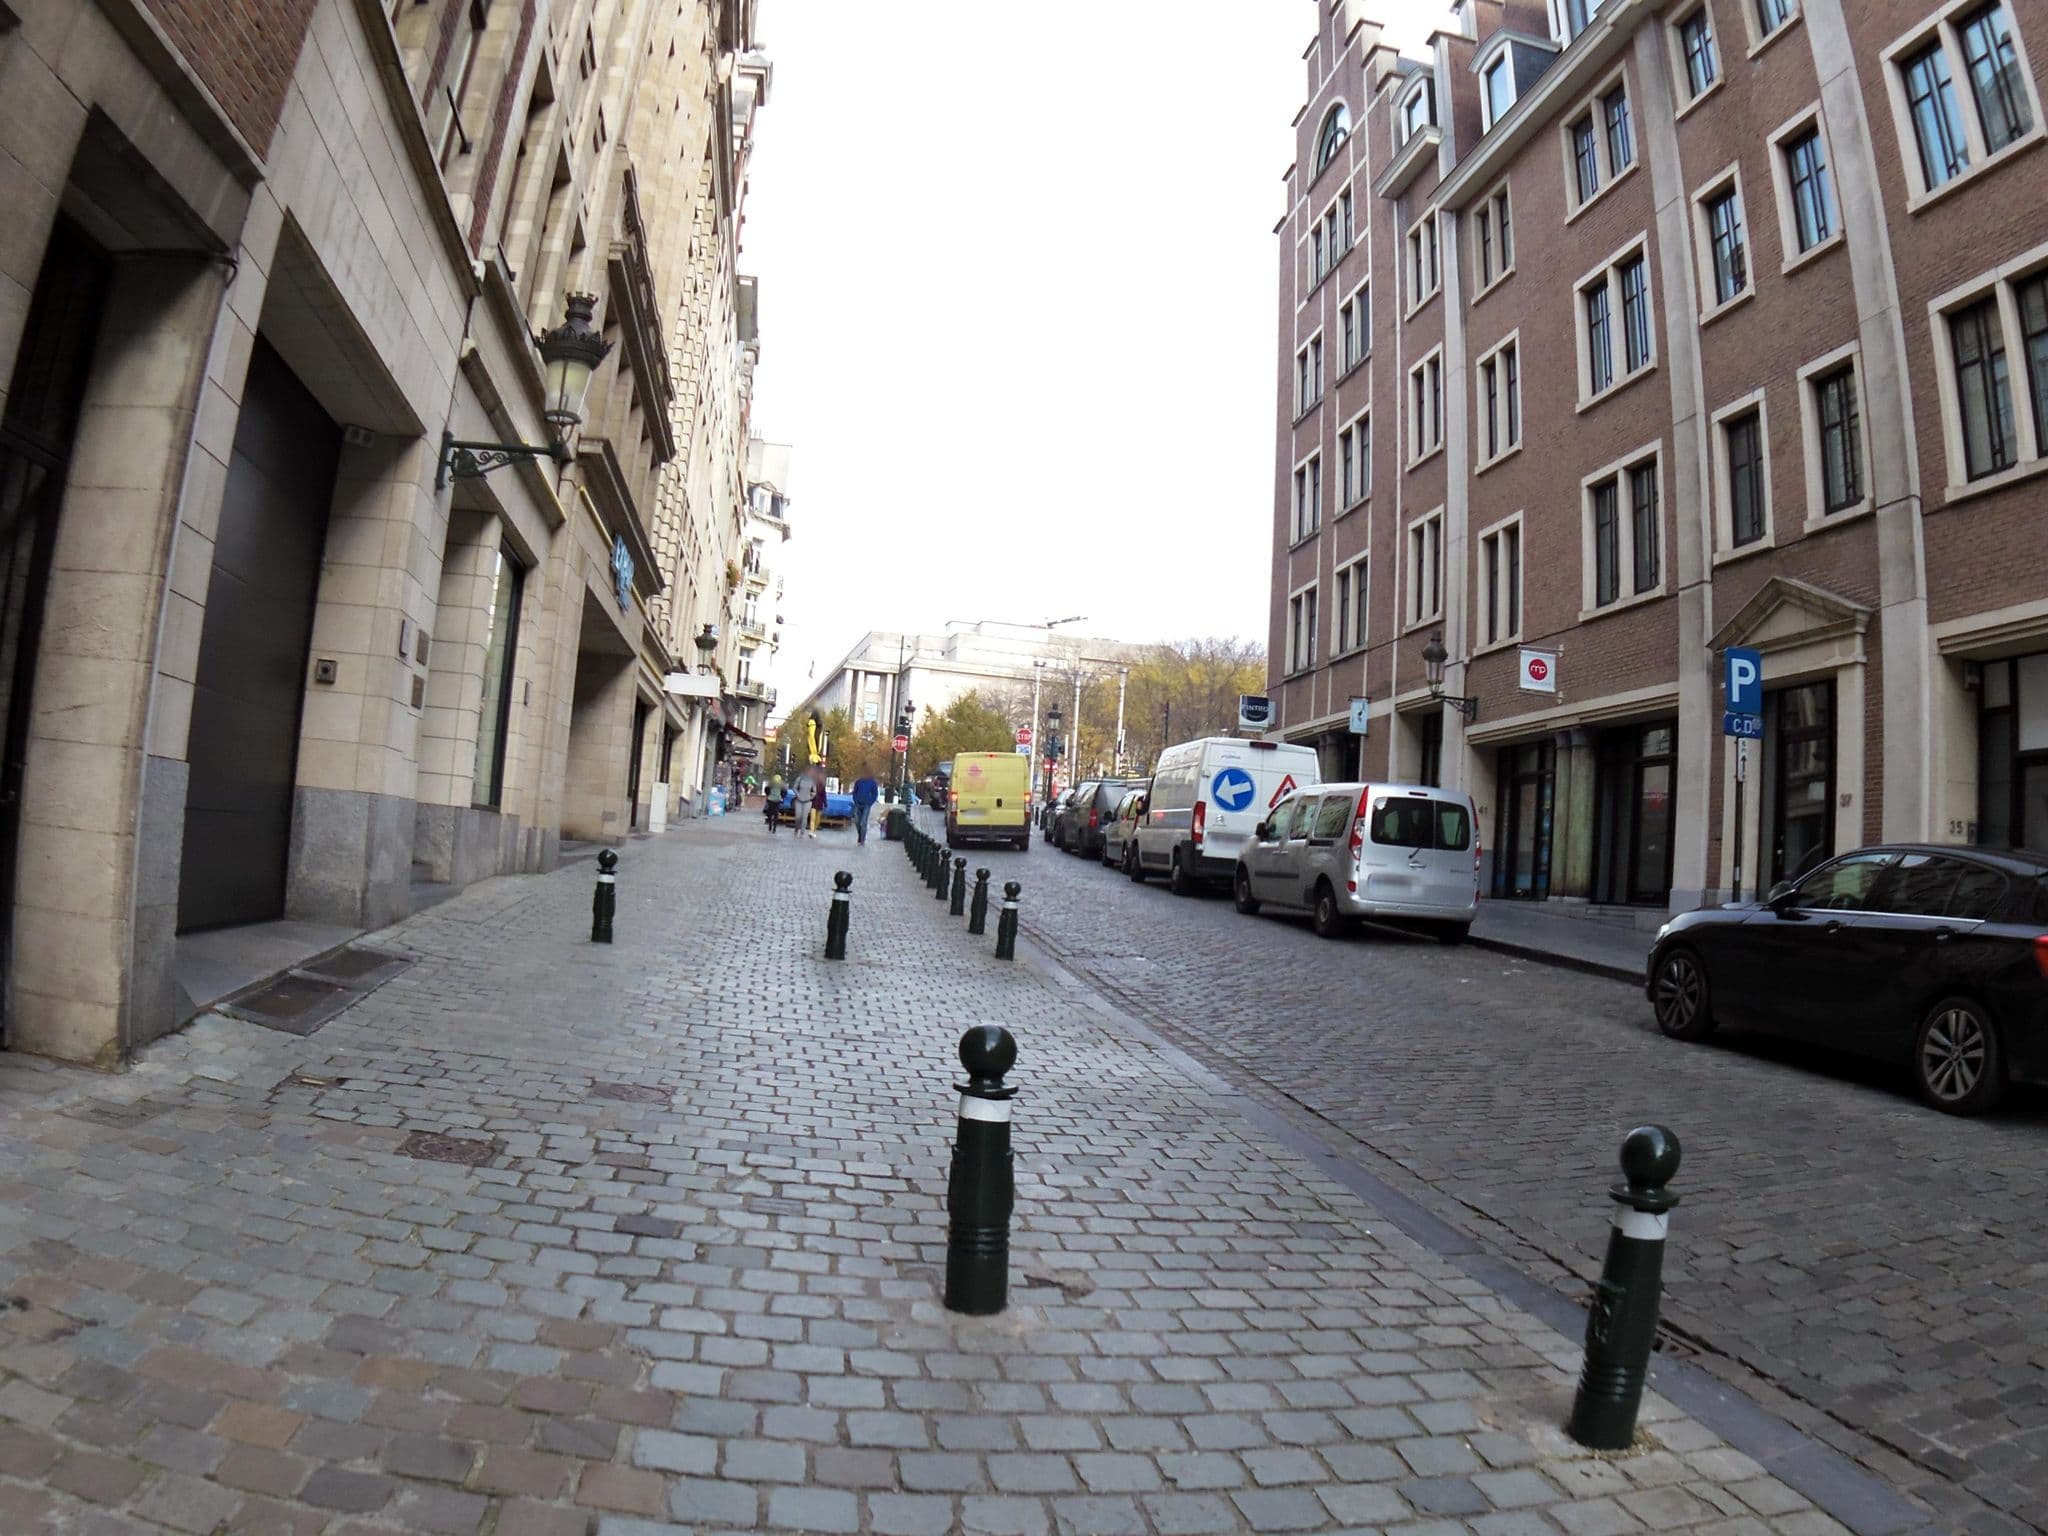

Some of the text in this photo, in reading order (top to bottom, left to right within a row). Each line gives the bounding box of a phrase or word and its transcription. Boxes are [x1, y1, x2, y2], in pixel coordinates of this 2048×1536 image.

[1731, 657, 1756, 703] P
[893, 739, 909, 747] STOP
[1016, 733, 1032, 741] STOP
[1839, 793, 1852, 808] 37
[1949, 820, 1964, 834] 35
